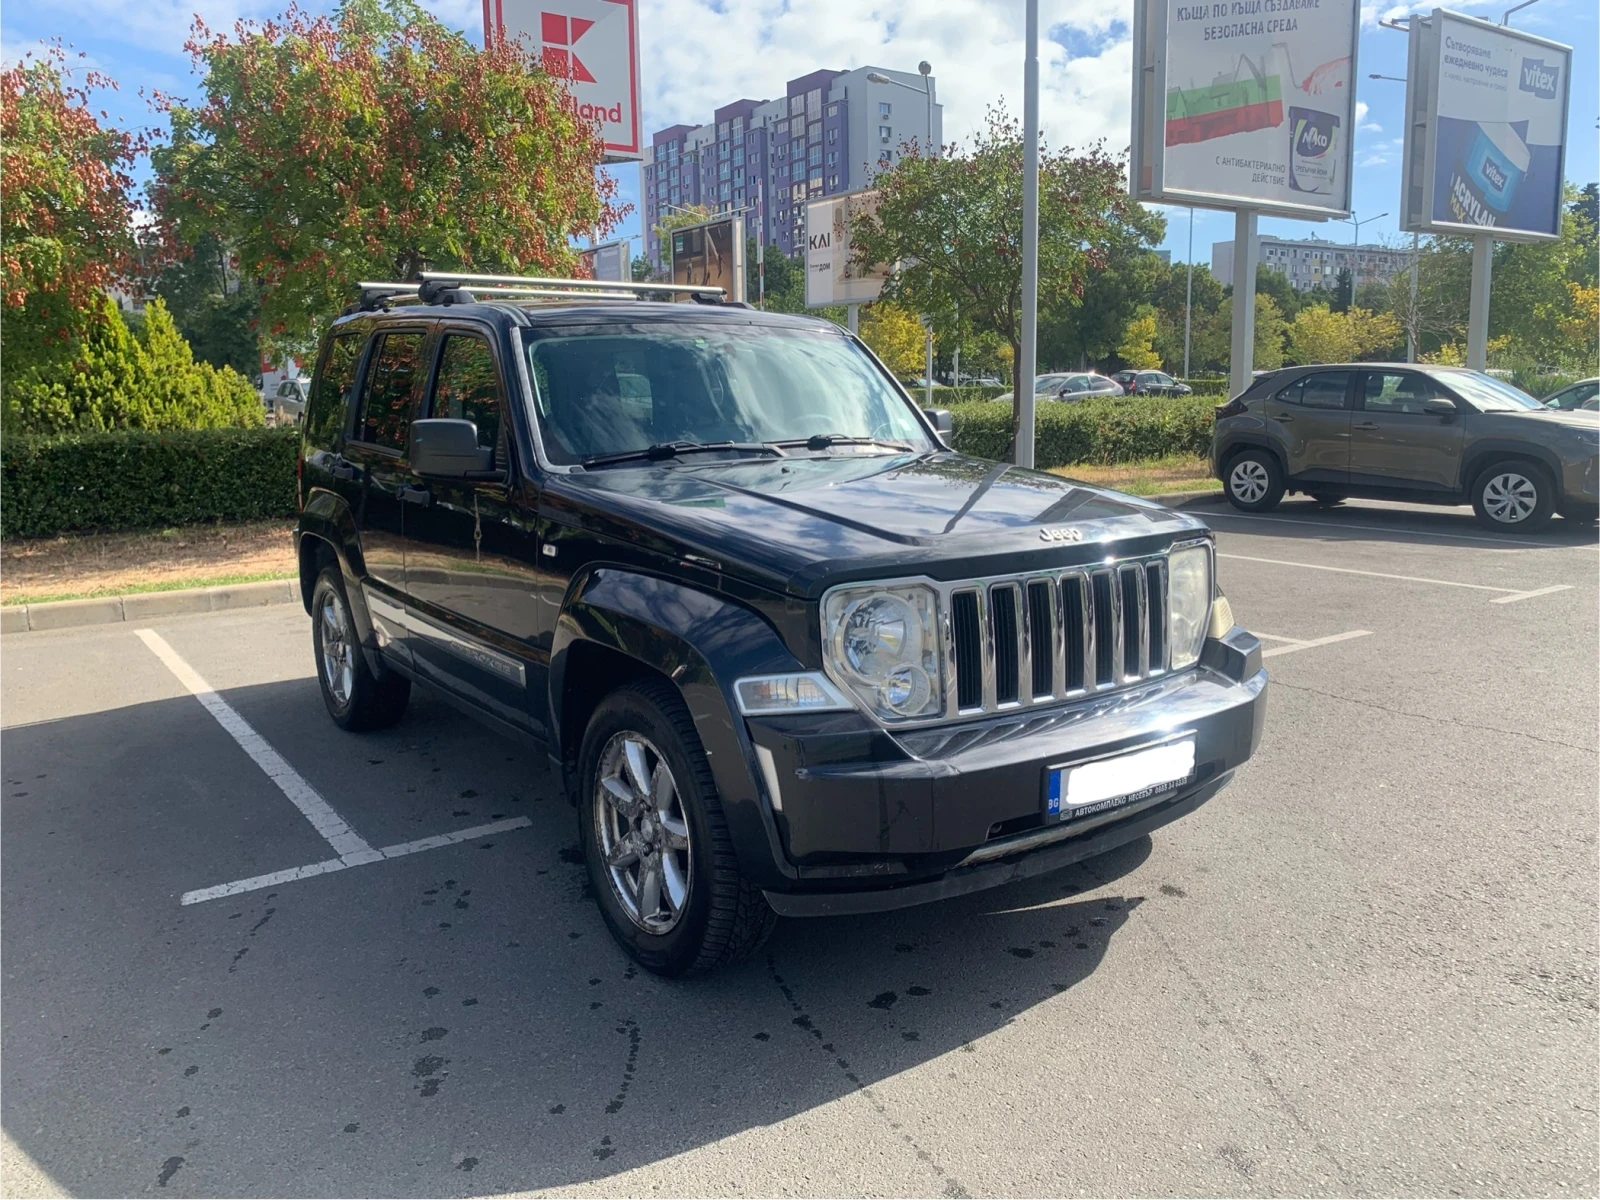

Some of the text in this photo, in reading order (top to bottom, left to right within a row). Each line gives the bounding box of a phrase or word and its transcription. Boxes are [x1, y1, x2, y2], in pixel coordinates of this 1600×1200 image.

[1177, 5, 1210, 21] КЪЩА
[1213, 3, 1228, 18] ПО
[1231, 0, 1261, 16] КЪЩА
[1204, 18, 1298, 41] БЕЗОПАСНА СРЕДА
[1445, 36, 1491, 59] Сътворяваме
[1444, 54, 1508, 78] ежедневно чудеса
[1524, 65, 1555, 92] vitex
[1215, 156, 1286, 173] С АНТИБАКТЕРИАЛНО
[1252, 172, 1285, 186] ДЕЙСТВИЕ
[1486, 163, 1505, 188] vitex
[1454, 175, 1496, 227] ACRYLAN
[809, 233, 830, 250] KAI
[1039, 527, 1083, 542] Jeep
[1048, 798, 1059, 809] BG
[1075, 796, 1126, 817] АВТОКОМПЛЕКС
